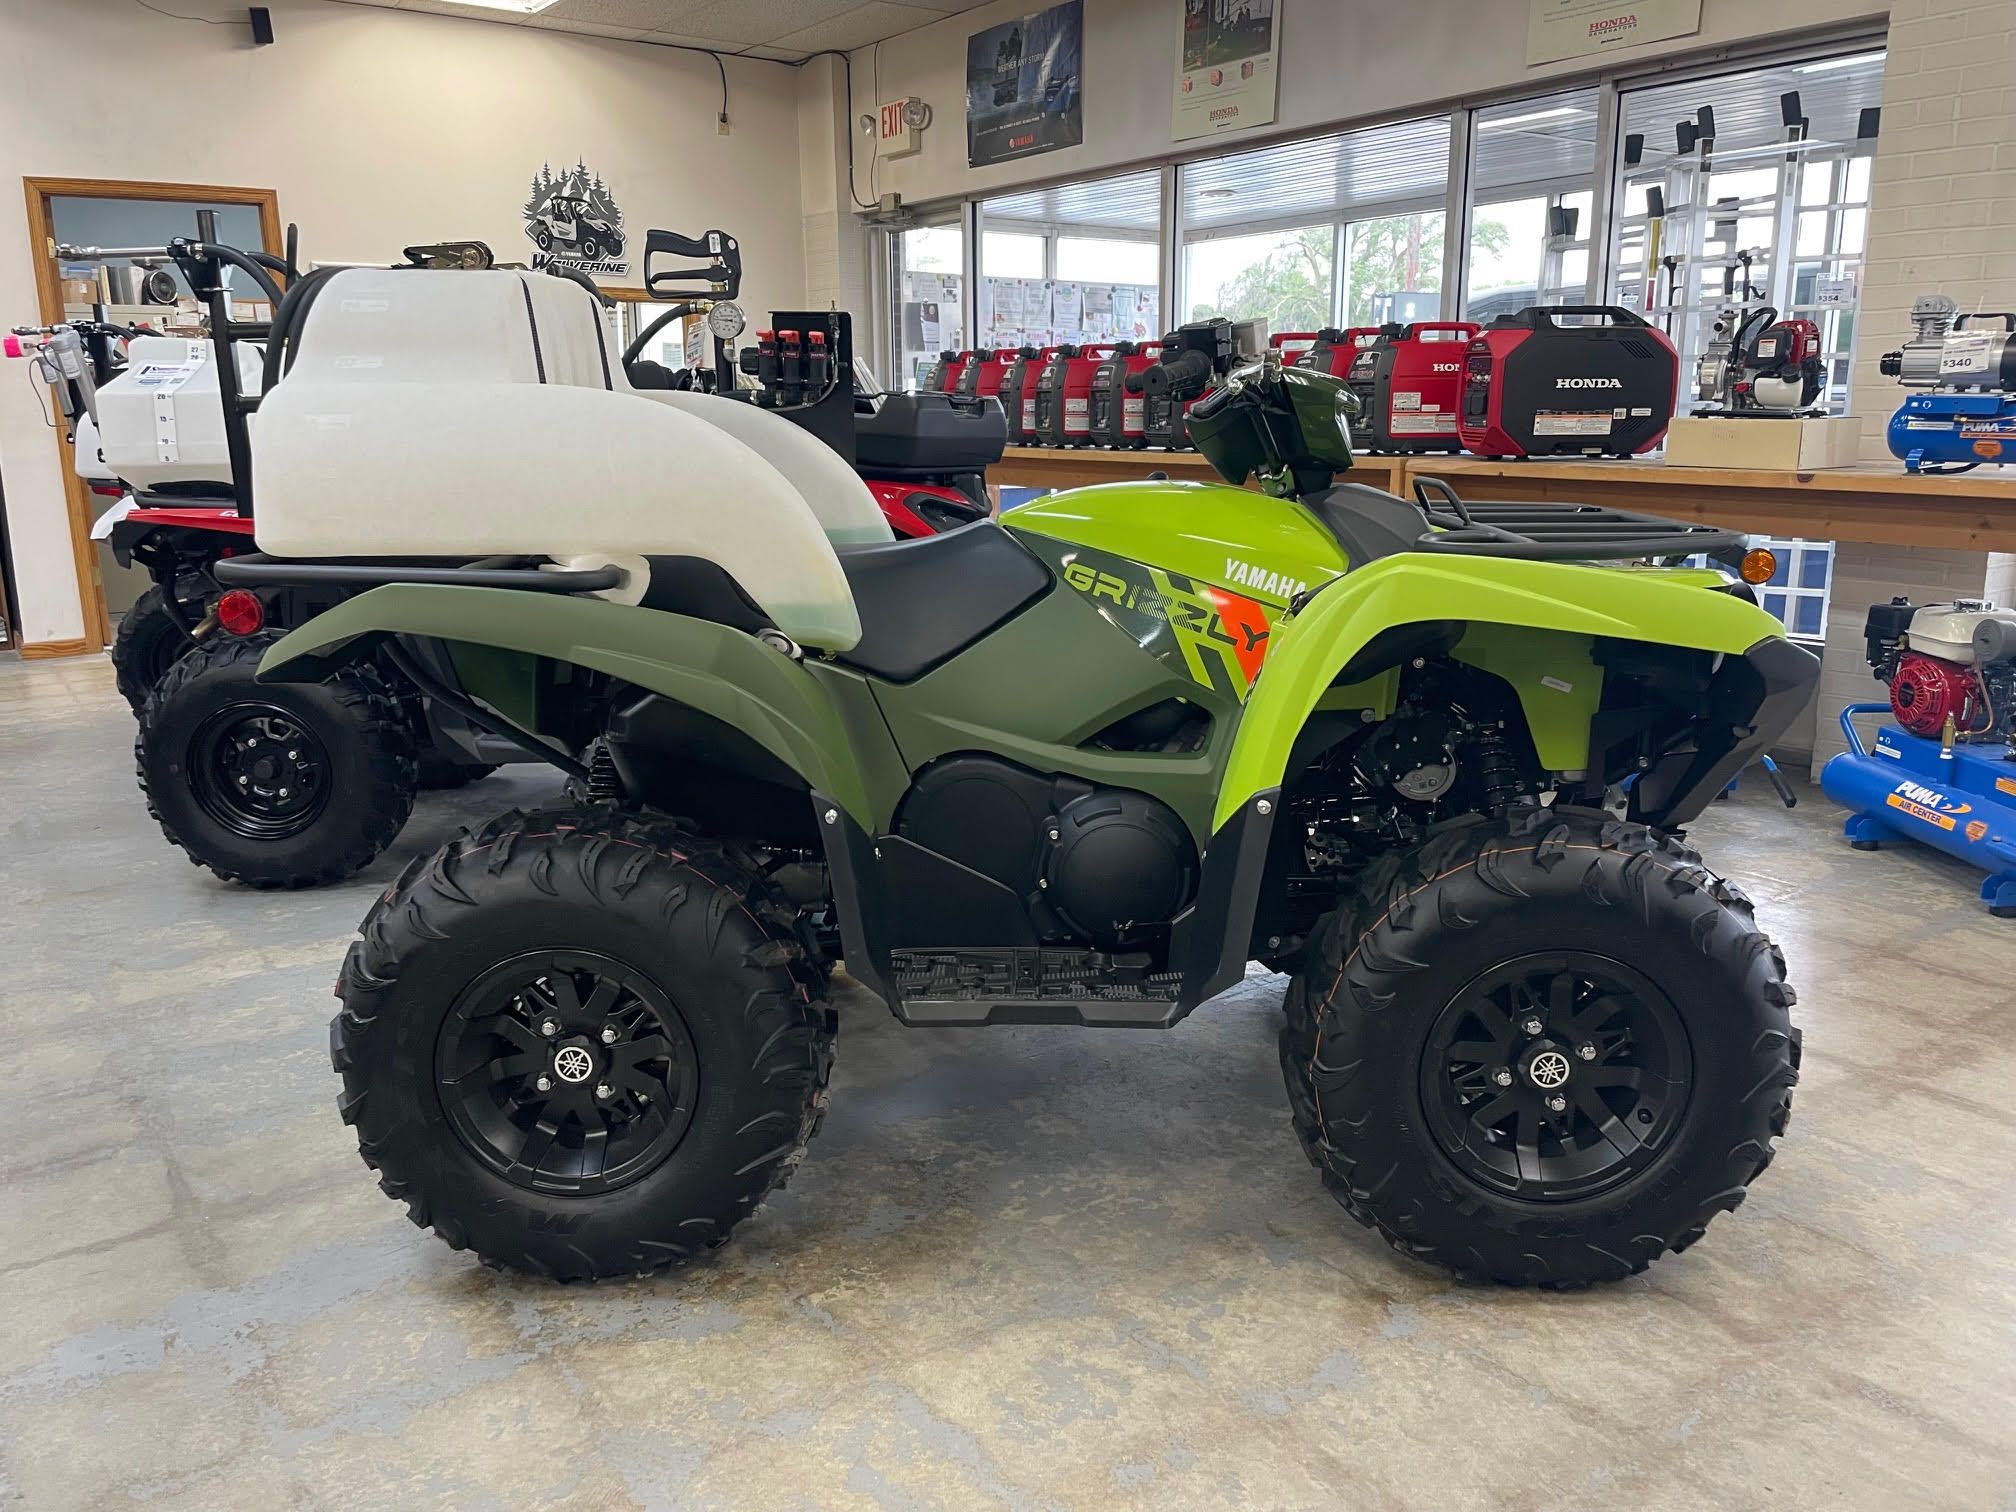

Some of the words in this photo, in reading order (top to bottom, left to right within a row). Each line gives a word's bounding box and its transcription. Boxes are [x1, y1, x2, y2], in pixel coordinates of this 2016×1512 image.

[1589, 14, 1637, 31] HONDA
[882, 102, 904, 139] EXIT
[1209, 105, 1240, 118] HONDA
[532, 253, 628, 273] WVERINE
[1943, 358, 1972, 368] $340
[1555, 378, 1623, 389] HONDA
[1962, 422, 1999, 432] PUMA
[1225, 558, 1306, 599] YAMAHA
[1064, 563, 1269, 651] GRIZZLY
[1894, 780, 1944, 809] PUMA
[1898, 800, 1911, 811] AIR
[1912, 805, 1942, 824] CENTER
